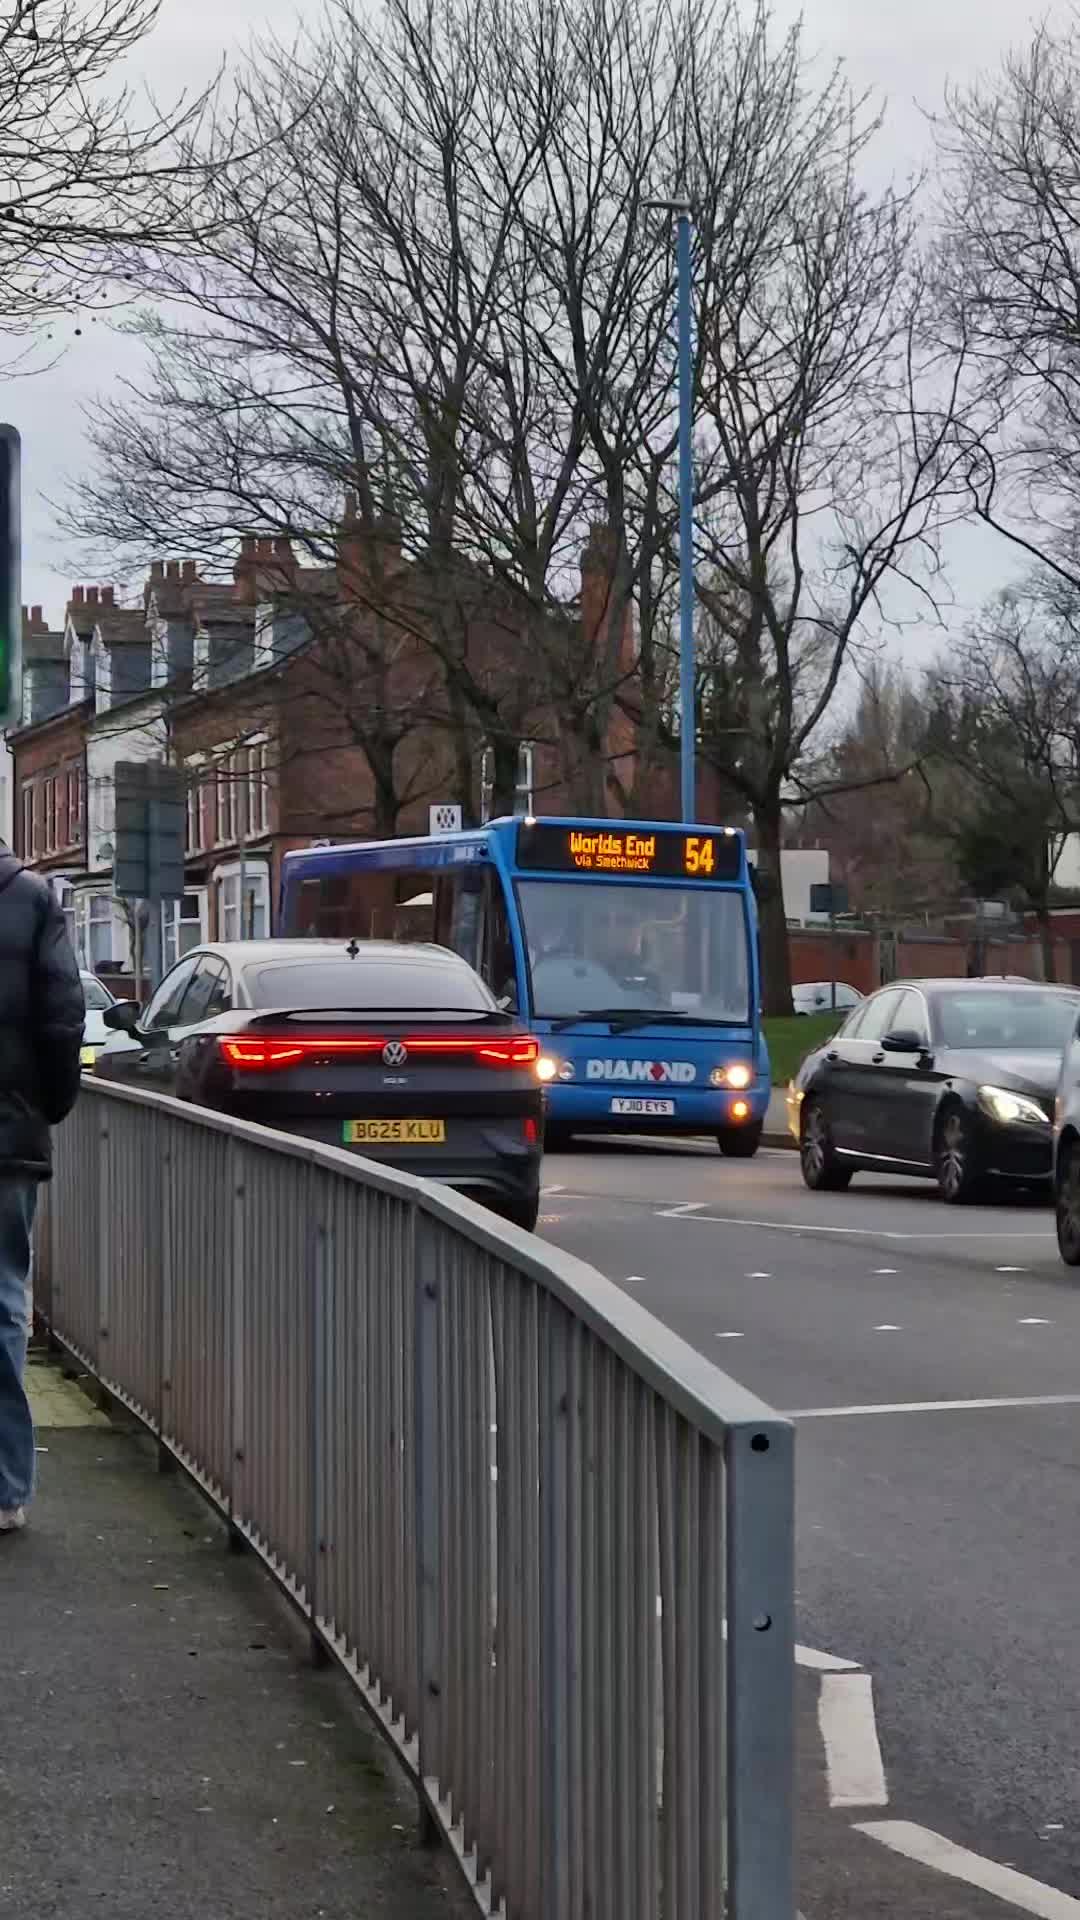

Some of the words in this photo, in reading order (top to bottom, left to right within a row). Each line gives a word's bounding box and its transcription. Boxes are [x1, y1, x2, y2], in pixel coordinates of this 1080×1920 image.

[570, 832, 622, 854] Worlds
[625, 835, 655, 857] End
[596, 855, 649, 869] Smethwick
[686, 837, 715, 872] 54
[618, 1100, 642, 1112] YJ10
[645, 1101, 668, 1113] EYS
[356, 1122, 401, 1138] BG25
[406, 1122, 440, 1138] KLU
